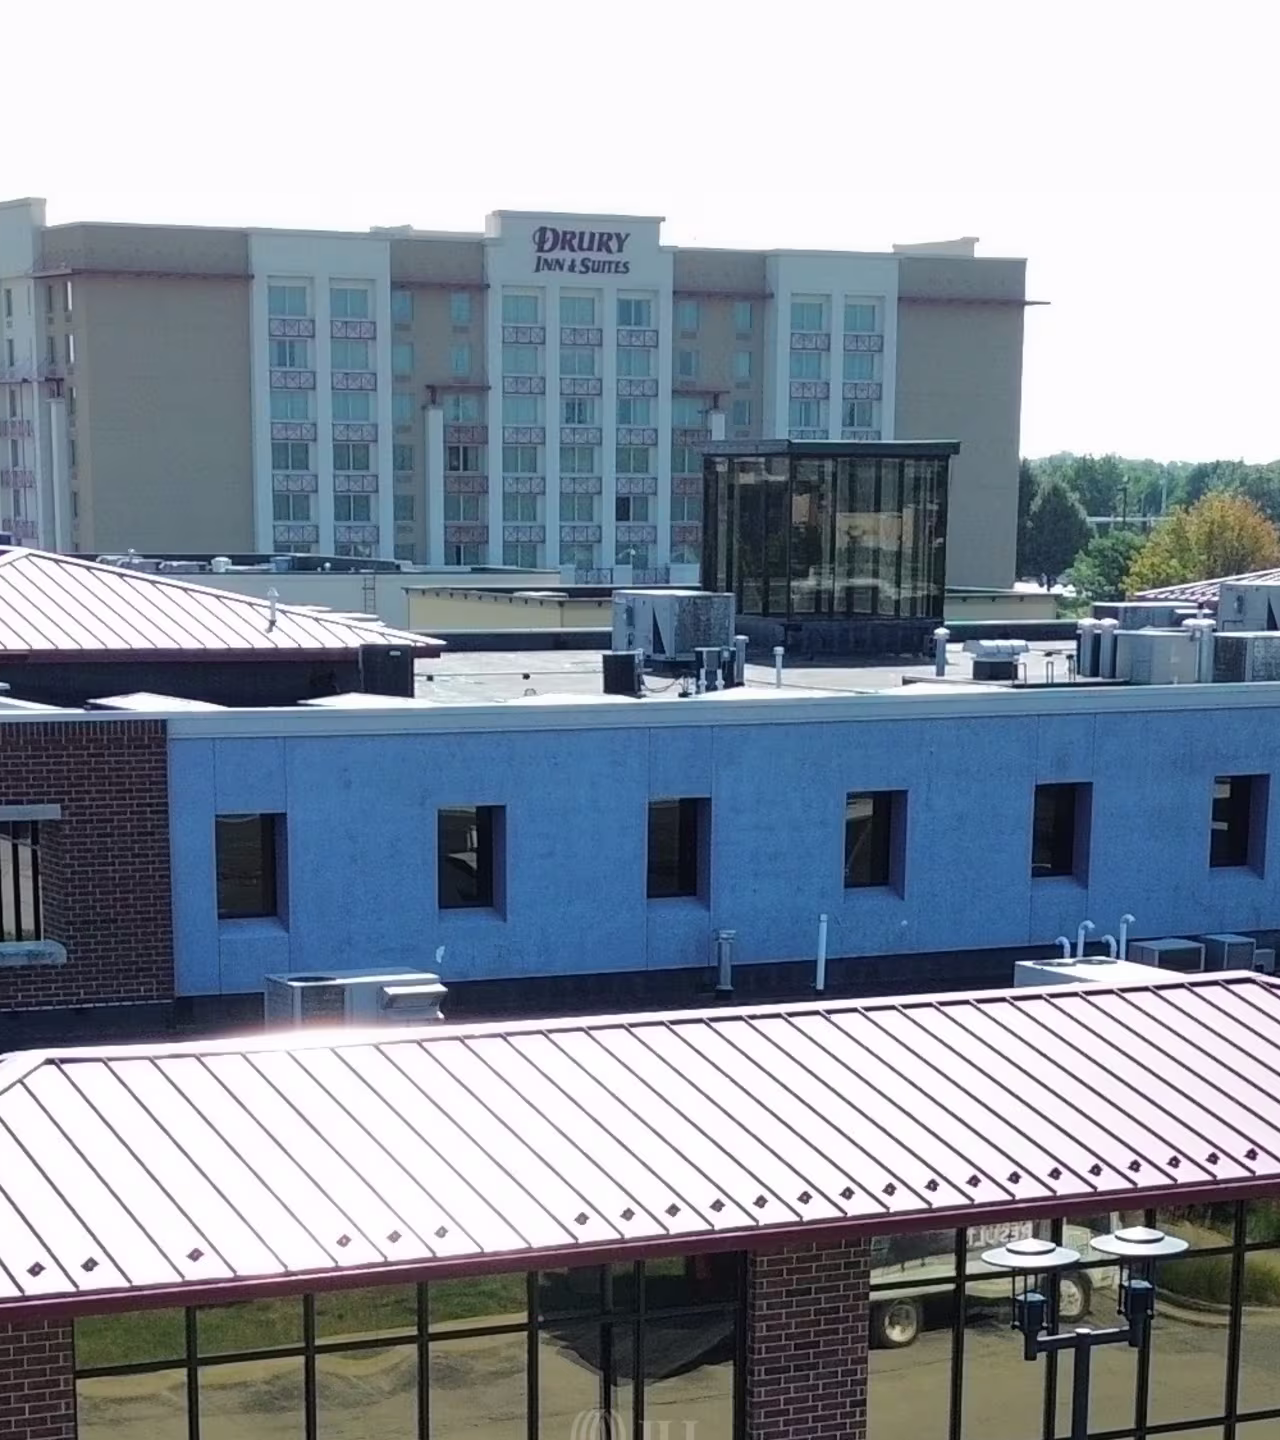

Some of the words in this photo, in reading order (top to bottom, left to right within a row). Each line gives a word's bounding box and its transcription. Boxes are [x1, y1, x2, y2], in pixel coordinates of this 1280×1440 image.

[532, 226, 631, 254] DRURY
[533, 255, 566, 273] INN
[568, 258, 577, 273] &
[578, 257, 630, 274] SUITES
